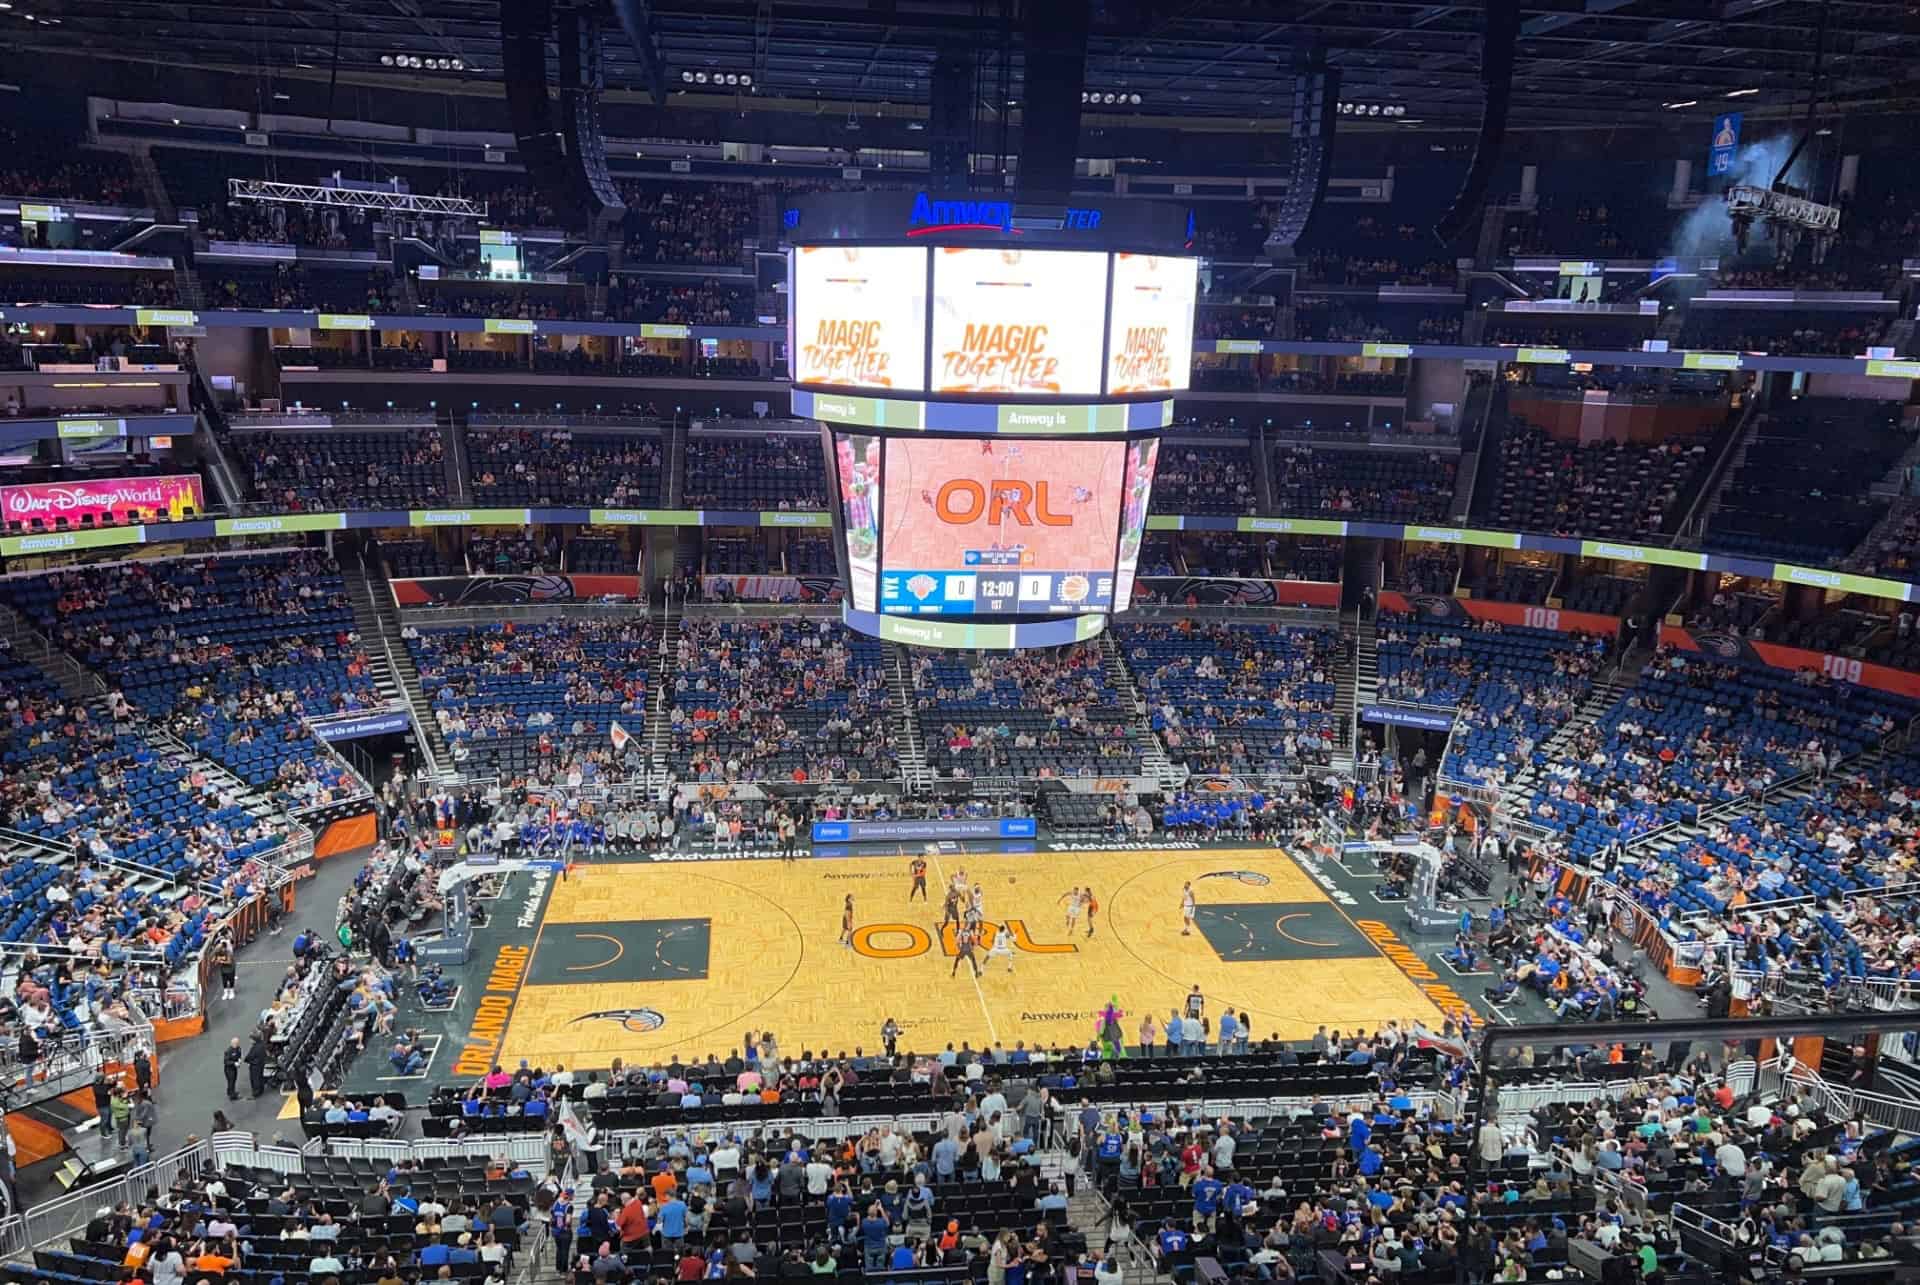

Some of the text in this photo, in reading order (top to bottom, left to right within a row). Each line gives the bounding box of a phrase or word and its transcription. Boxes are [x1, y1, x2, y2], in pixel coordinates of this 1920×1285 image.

[910, 191, 1101, 233] Amway TER
[816, 319, 881, 347] MAGIC
[962, 323, 1048, 352] MAGIC
[1125, 326, 1168, 353] MAGIC
[803, 344, 890, 378] TOGETHER
[943, 350, 1059, 383] TOGETHER
[1008, 411, 1055, 428] Amway
[117, 487, 162, 503] World
[935, 478, 1073, 526] ORL
[958, 580, 965, 595] 0
[982, 580, 1014, 597] 12:00
[1032, 580, 1039, 595] 0
[1523, 607, 1560, 630] 108
[1823, 654, 1863, 684] 109
[669, 848, 811, 861] AdventHealth
[1070, 842, 1200, 851] AdventHealth
[823, 872, 871, 880] Amway
[851, 919, 1080, 959] ORL
[1356, 919, 1440, 980] ORLANDO
[456, 944, 530, 1075] ORLANDO MAGIC
[1020, 1011, 1079, 1021] Amway
[1203, 1187, 1217, 1202] 7
